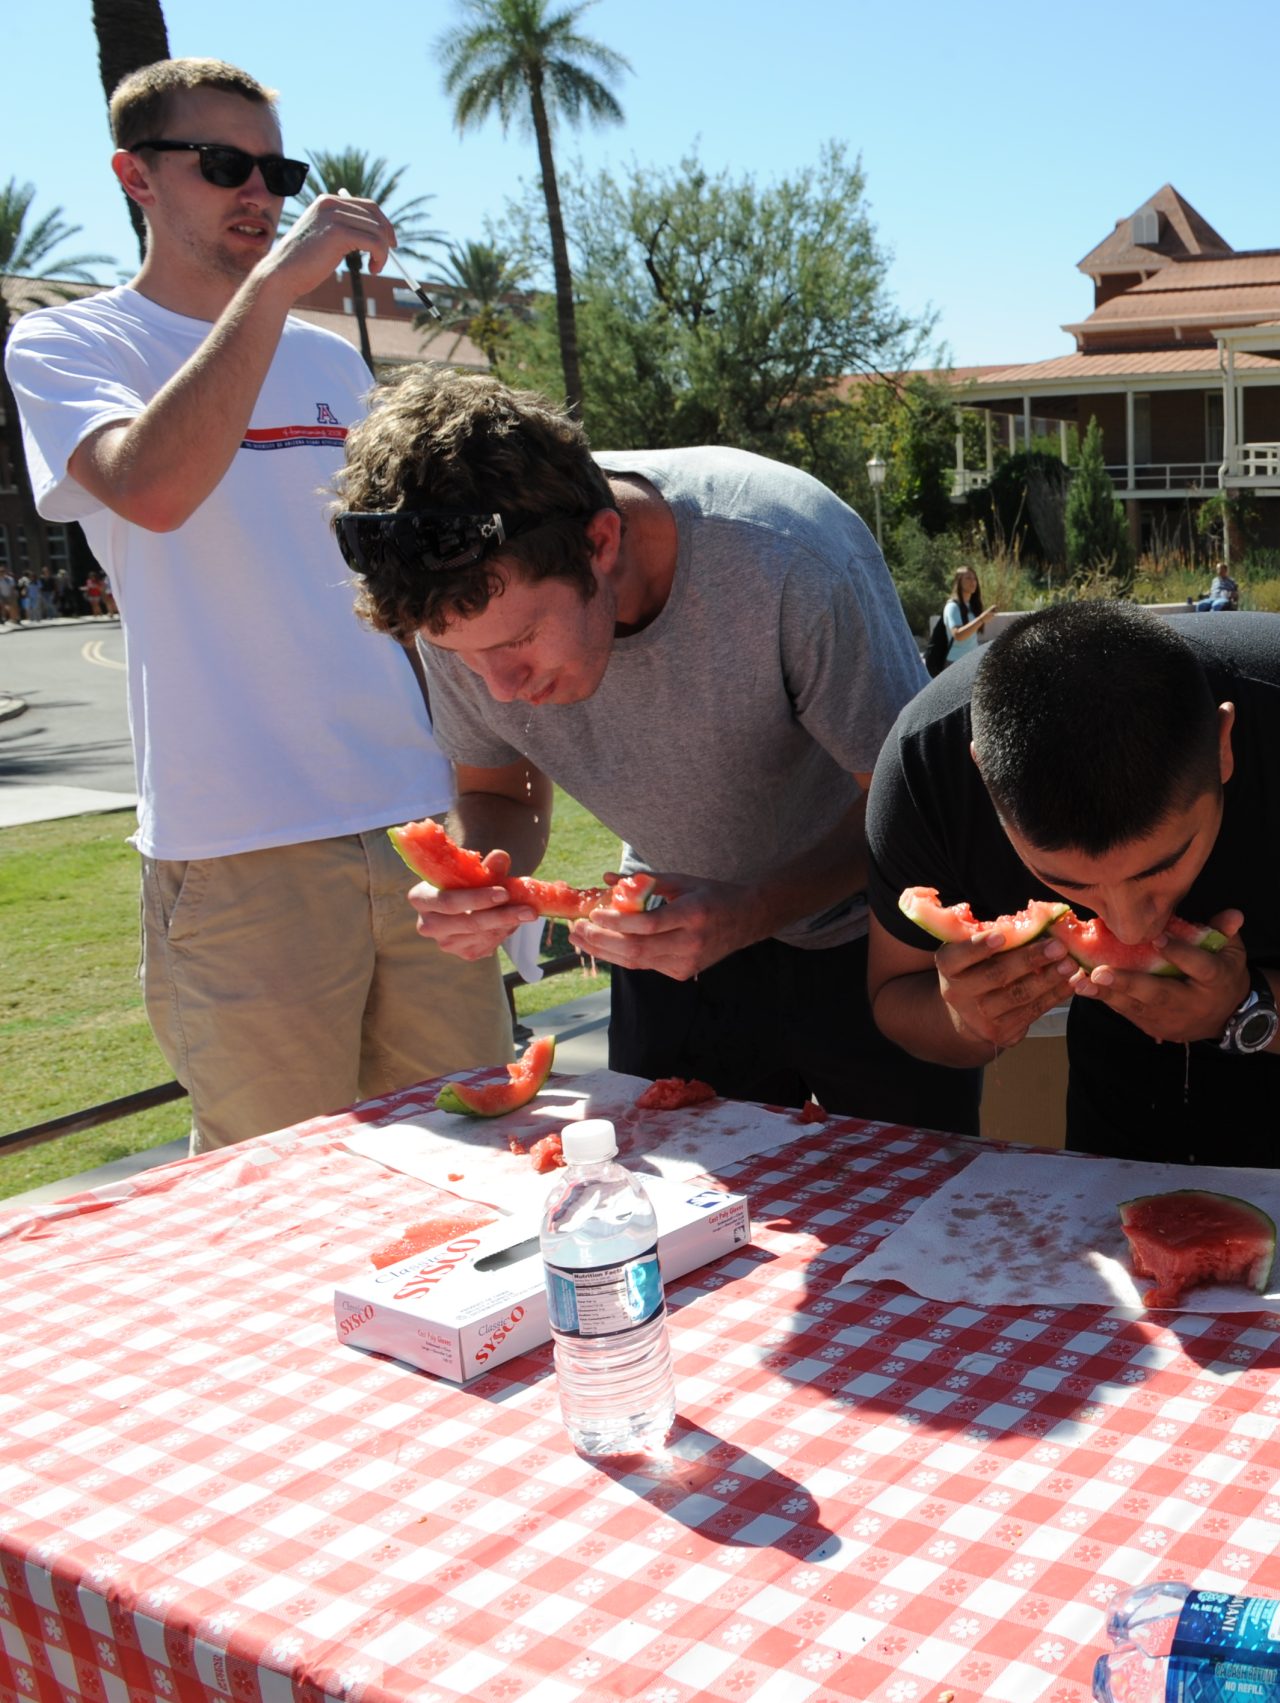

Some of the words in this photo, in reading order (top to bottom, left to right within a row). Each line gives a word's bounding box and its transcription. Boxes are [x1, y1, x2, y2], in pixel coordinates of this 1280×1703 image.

[393, 1239, 481, 1300] SYSCO
[340, 1304, 376, 1336] SYSCO
[475, 1305, 526, 1365] SYSCO
[478, 1317, 511, 1337] Classic
[1225, 1681, 1237, 1692] NO
[1237, 1682, 1264, 1695] REFILL
